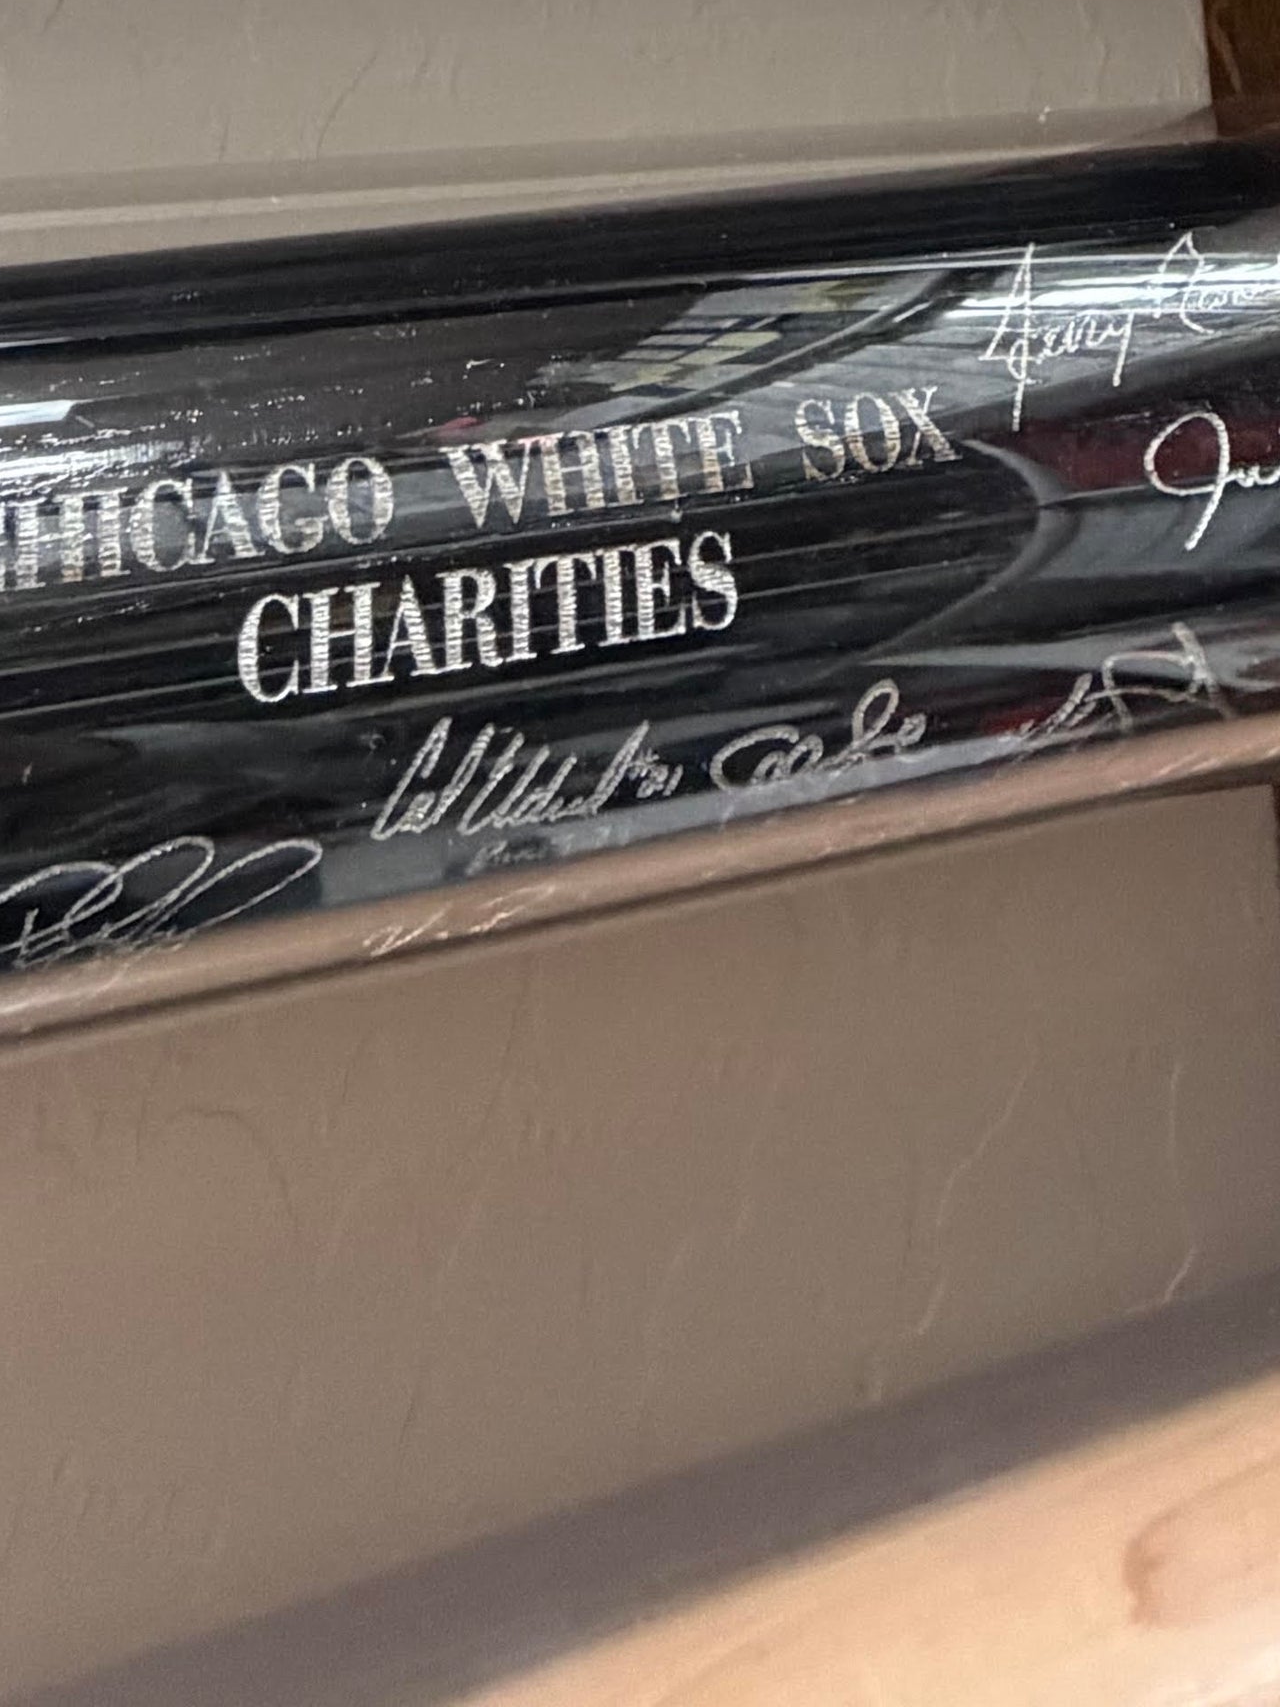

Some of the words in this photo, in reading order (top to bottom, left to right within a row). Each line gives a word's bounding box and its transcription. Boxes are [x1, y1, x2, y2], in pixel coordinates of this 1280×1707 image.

[446, 410, 758, 529] WHITE
[793, 385, 963, 481] SOX
[237, 529, 739, 704] CHARITIES
